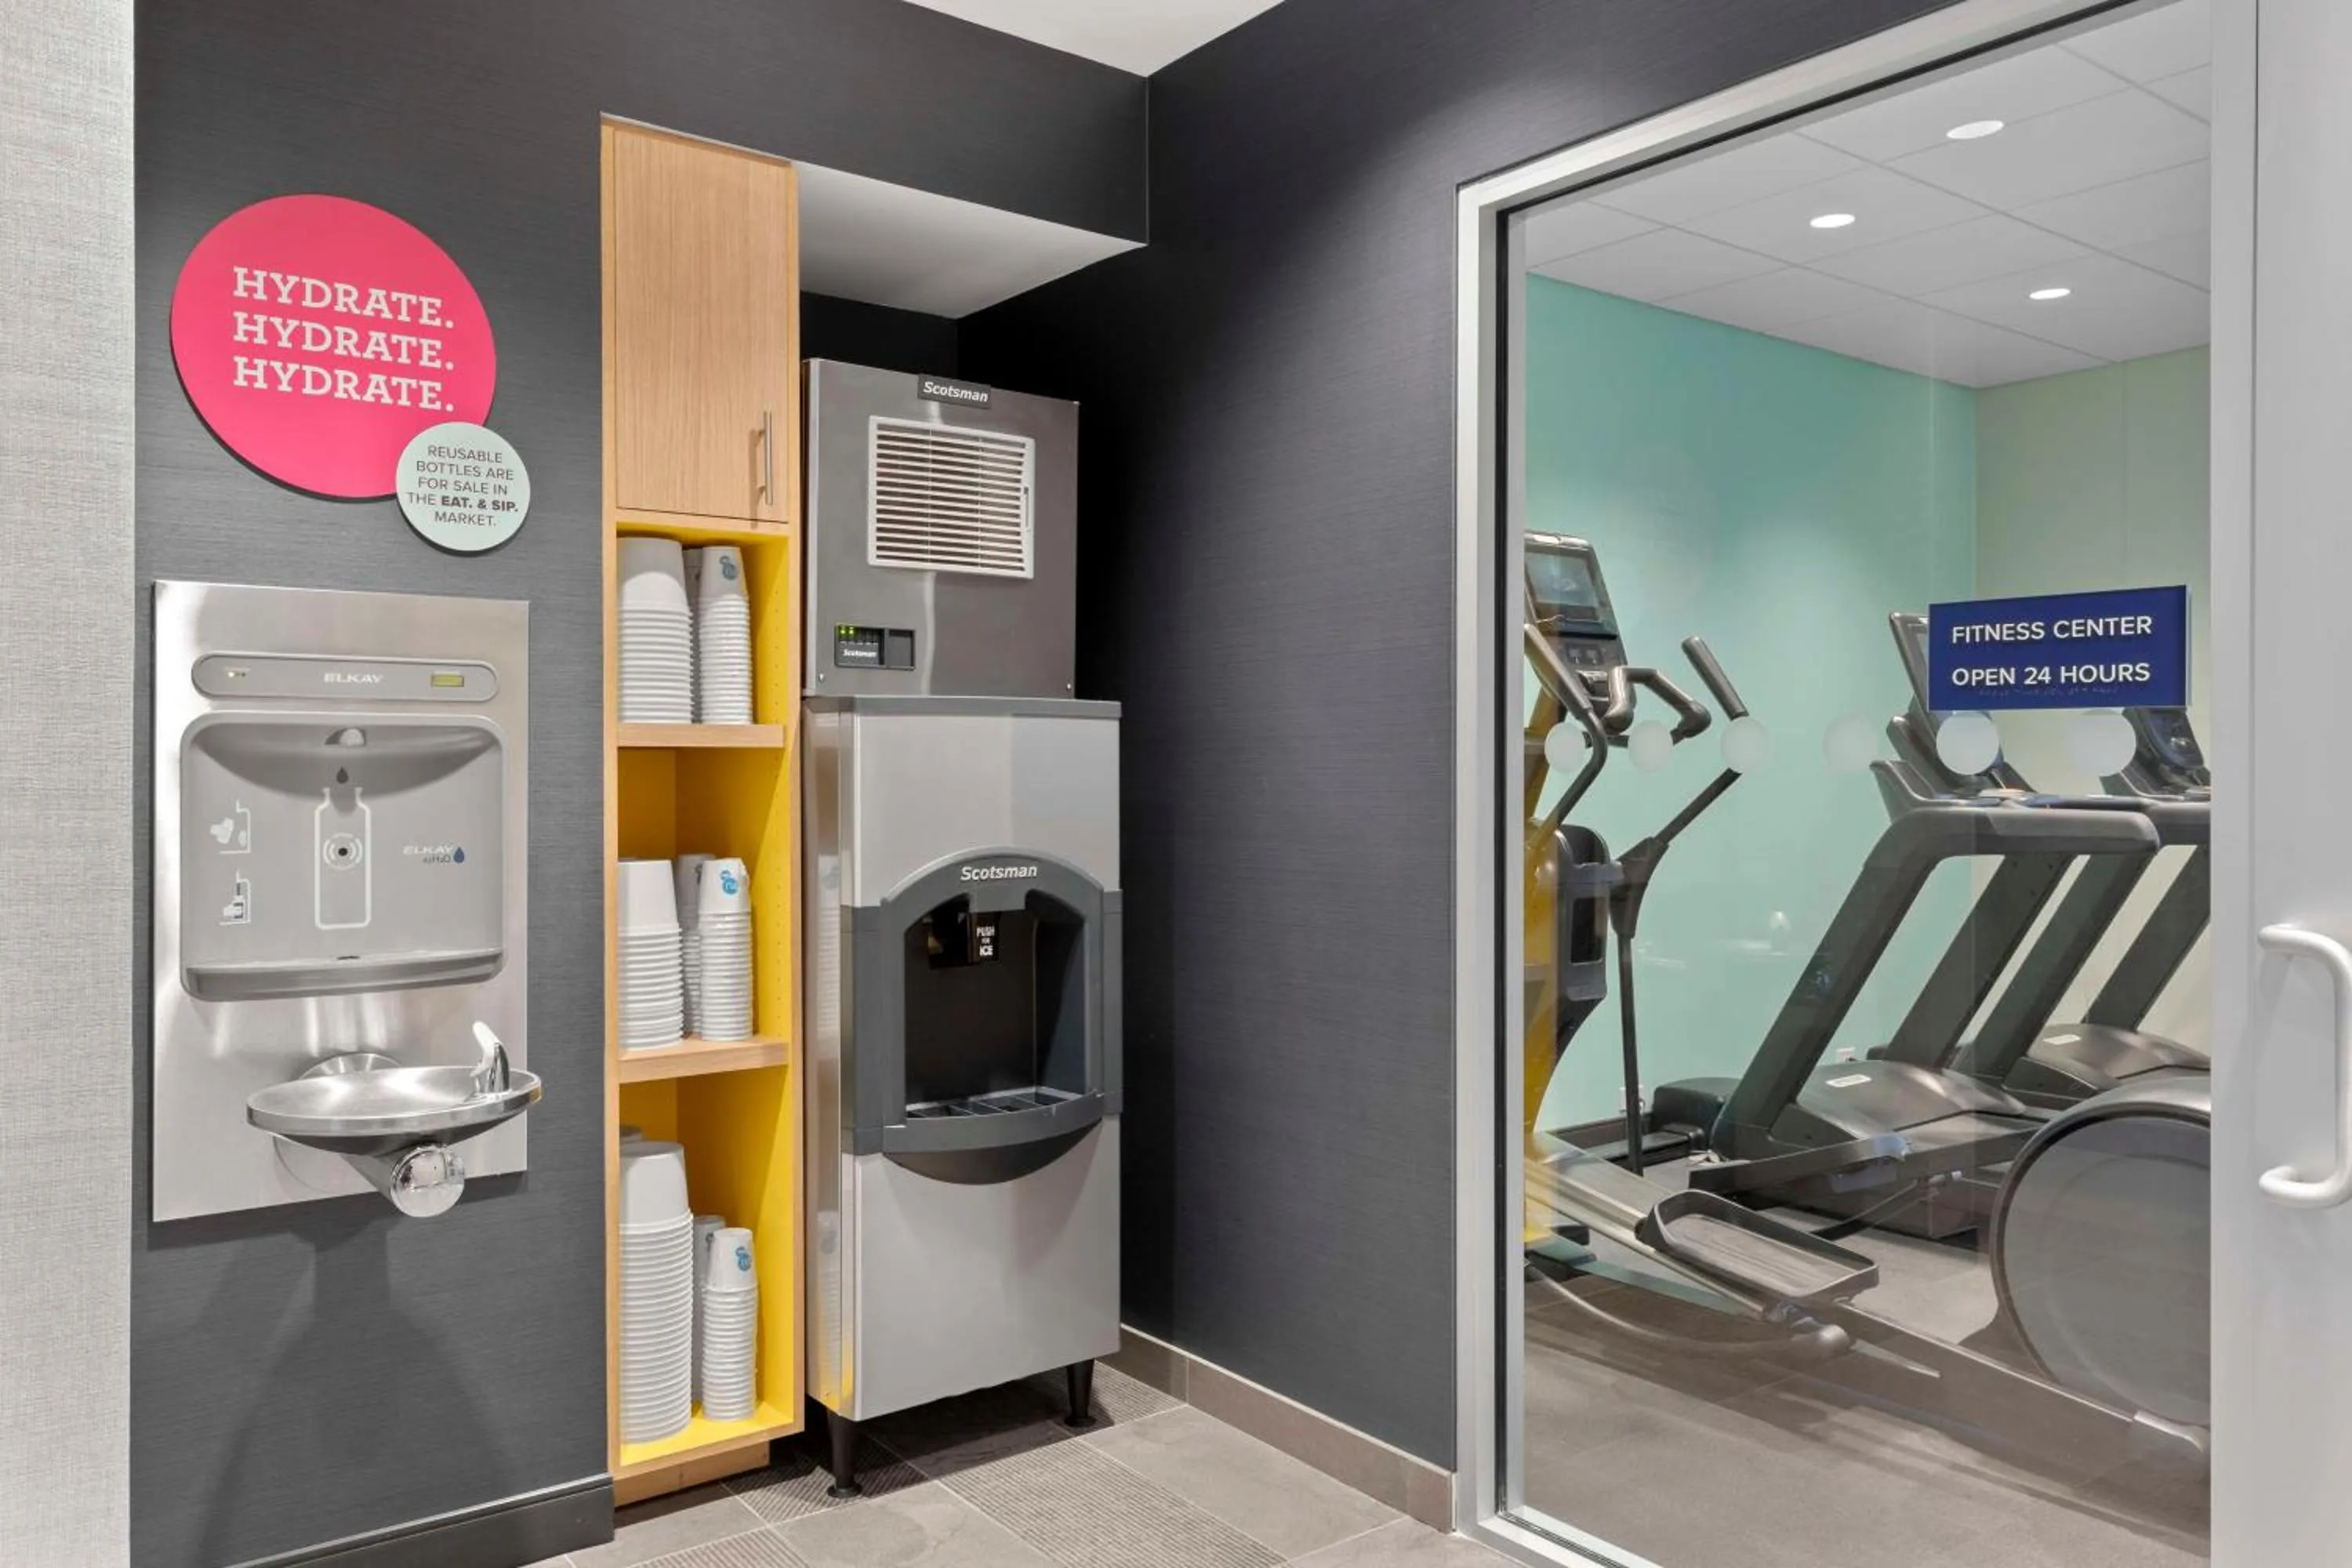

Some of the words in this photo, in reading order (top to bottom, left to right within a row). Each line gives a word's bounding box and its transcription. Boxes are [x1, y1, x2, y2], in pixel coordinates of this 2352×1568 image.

[233, 266, 454, 328] HYDRATE.
[233, 311, 454, 371] HYDRATE.
[233, 355, 454, 412] HYDRATE.
[923, 381, 989, 402] Scotsman
[428, 445, 503, 463] REUSABLE
[416, 460, 481, 477] BOTTLES
[485, 468, 514, 481] ARE
[418, 477, 448, 490] FOR
[453, 481, 489, 495] SALE
[493, 485, 508, 495] IN
[408, 492, 437, 506] THE
[441, 495, 474, 509] EAT.
[477, 499, 487, 509] &
[492, 500, 519, 512] SIP.
[434, 511, 497, 527] MARKET.
[1951, 621, 2045, 644] FITNESS
[2053, 615, 2152, 638] CENTER
[323, 673, 384, 684] ELKAY
[1951, 667, 2016, 686] OPEN
[2024, 666, 2052, 684] 24
[2060, 662, 2151, 684] HOURS
[960, 866, 1038, 880] Scotsman
[976, 926, 995, 937] PUSH
[979, 945, 993, 956] ICE
